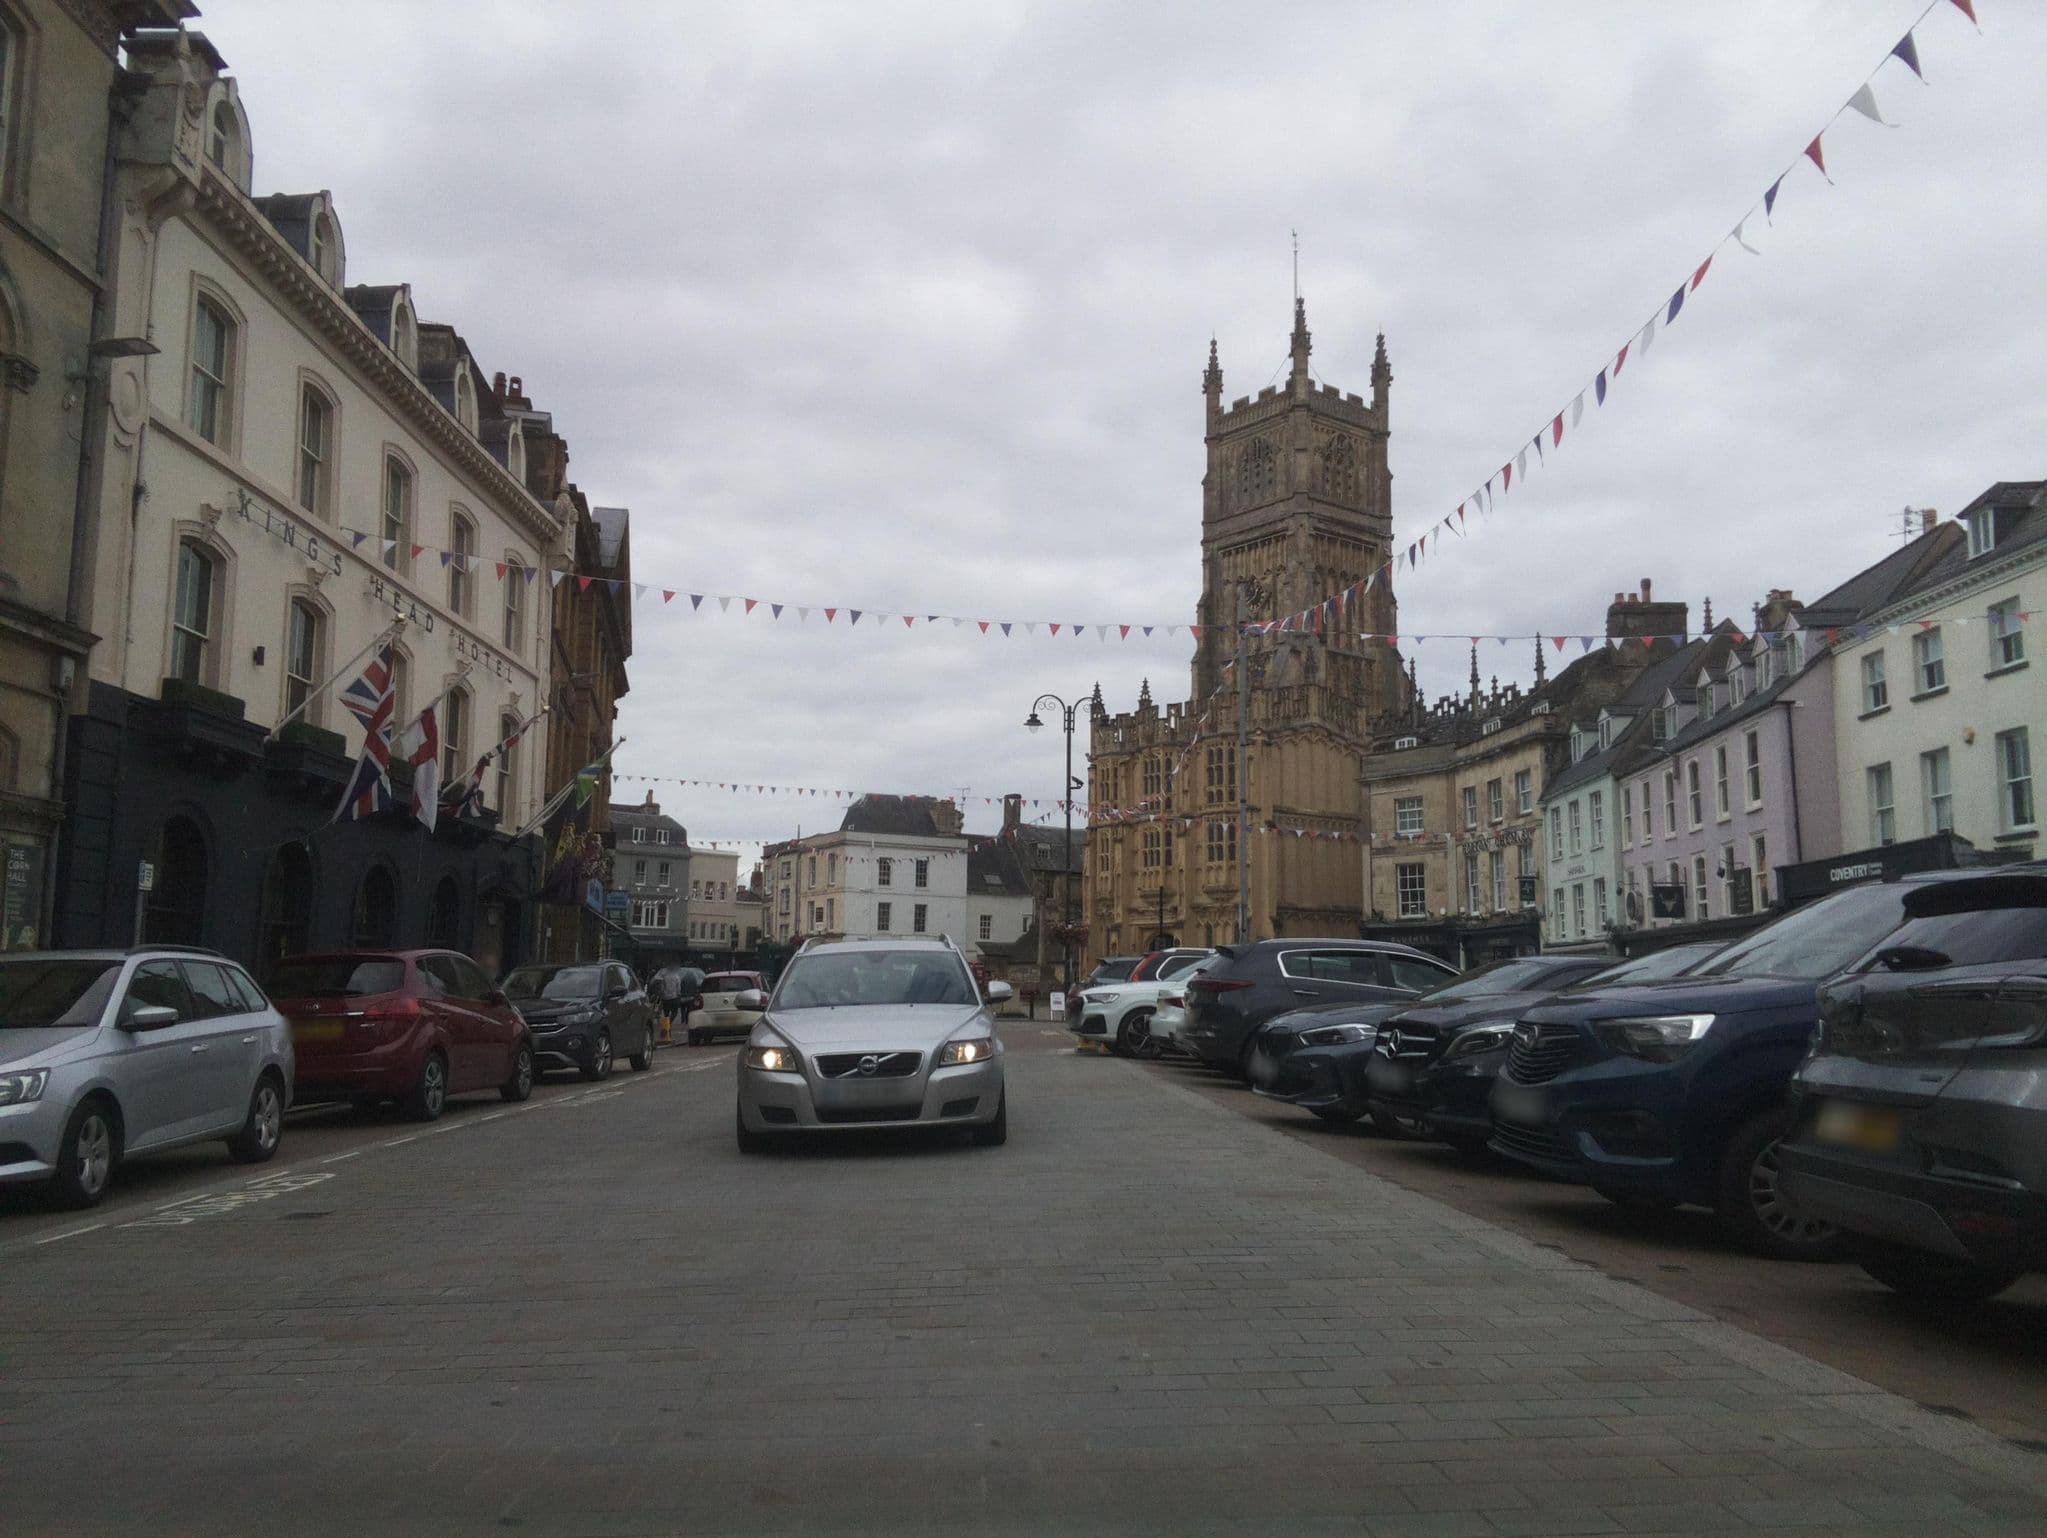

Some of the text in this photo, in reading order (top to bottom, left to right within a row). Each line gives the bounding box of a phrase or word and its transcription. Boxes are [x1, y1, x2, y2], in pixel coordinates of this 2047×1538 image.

[238, 490, 513, 684] KINGS HEAD HOTEL
[1830, 864, 1868, 882] COVENTRY
